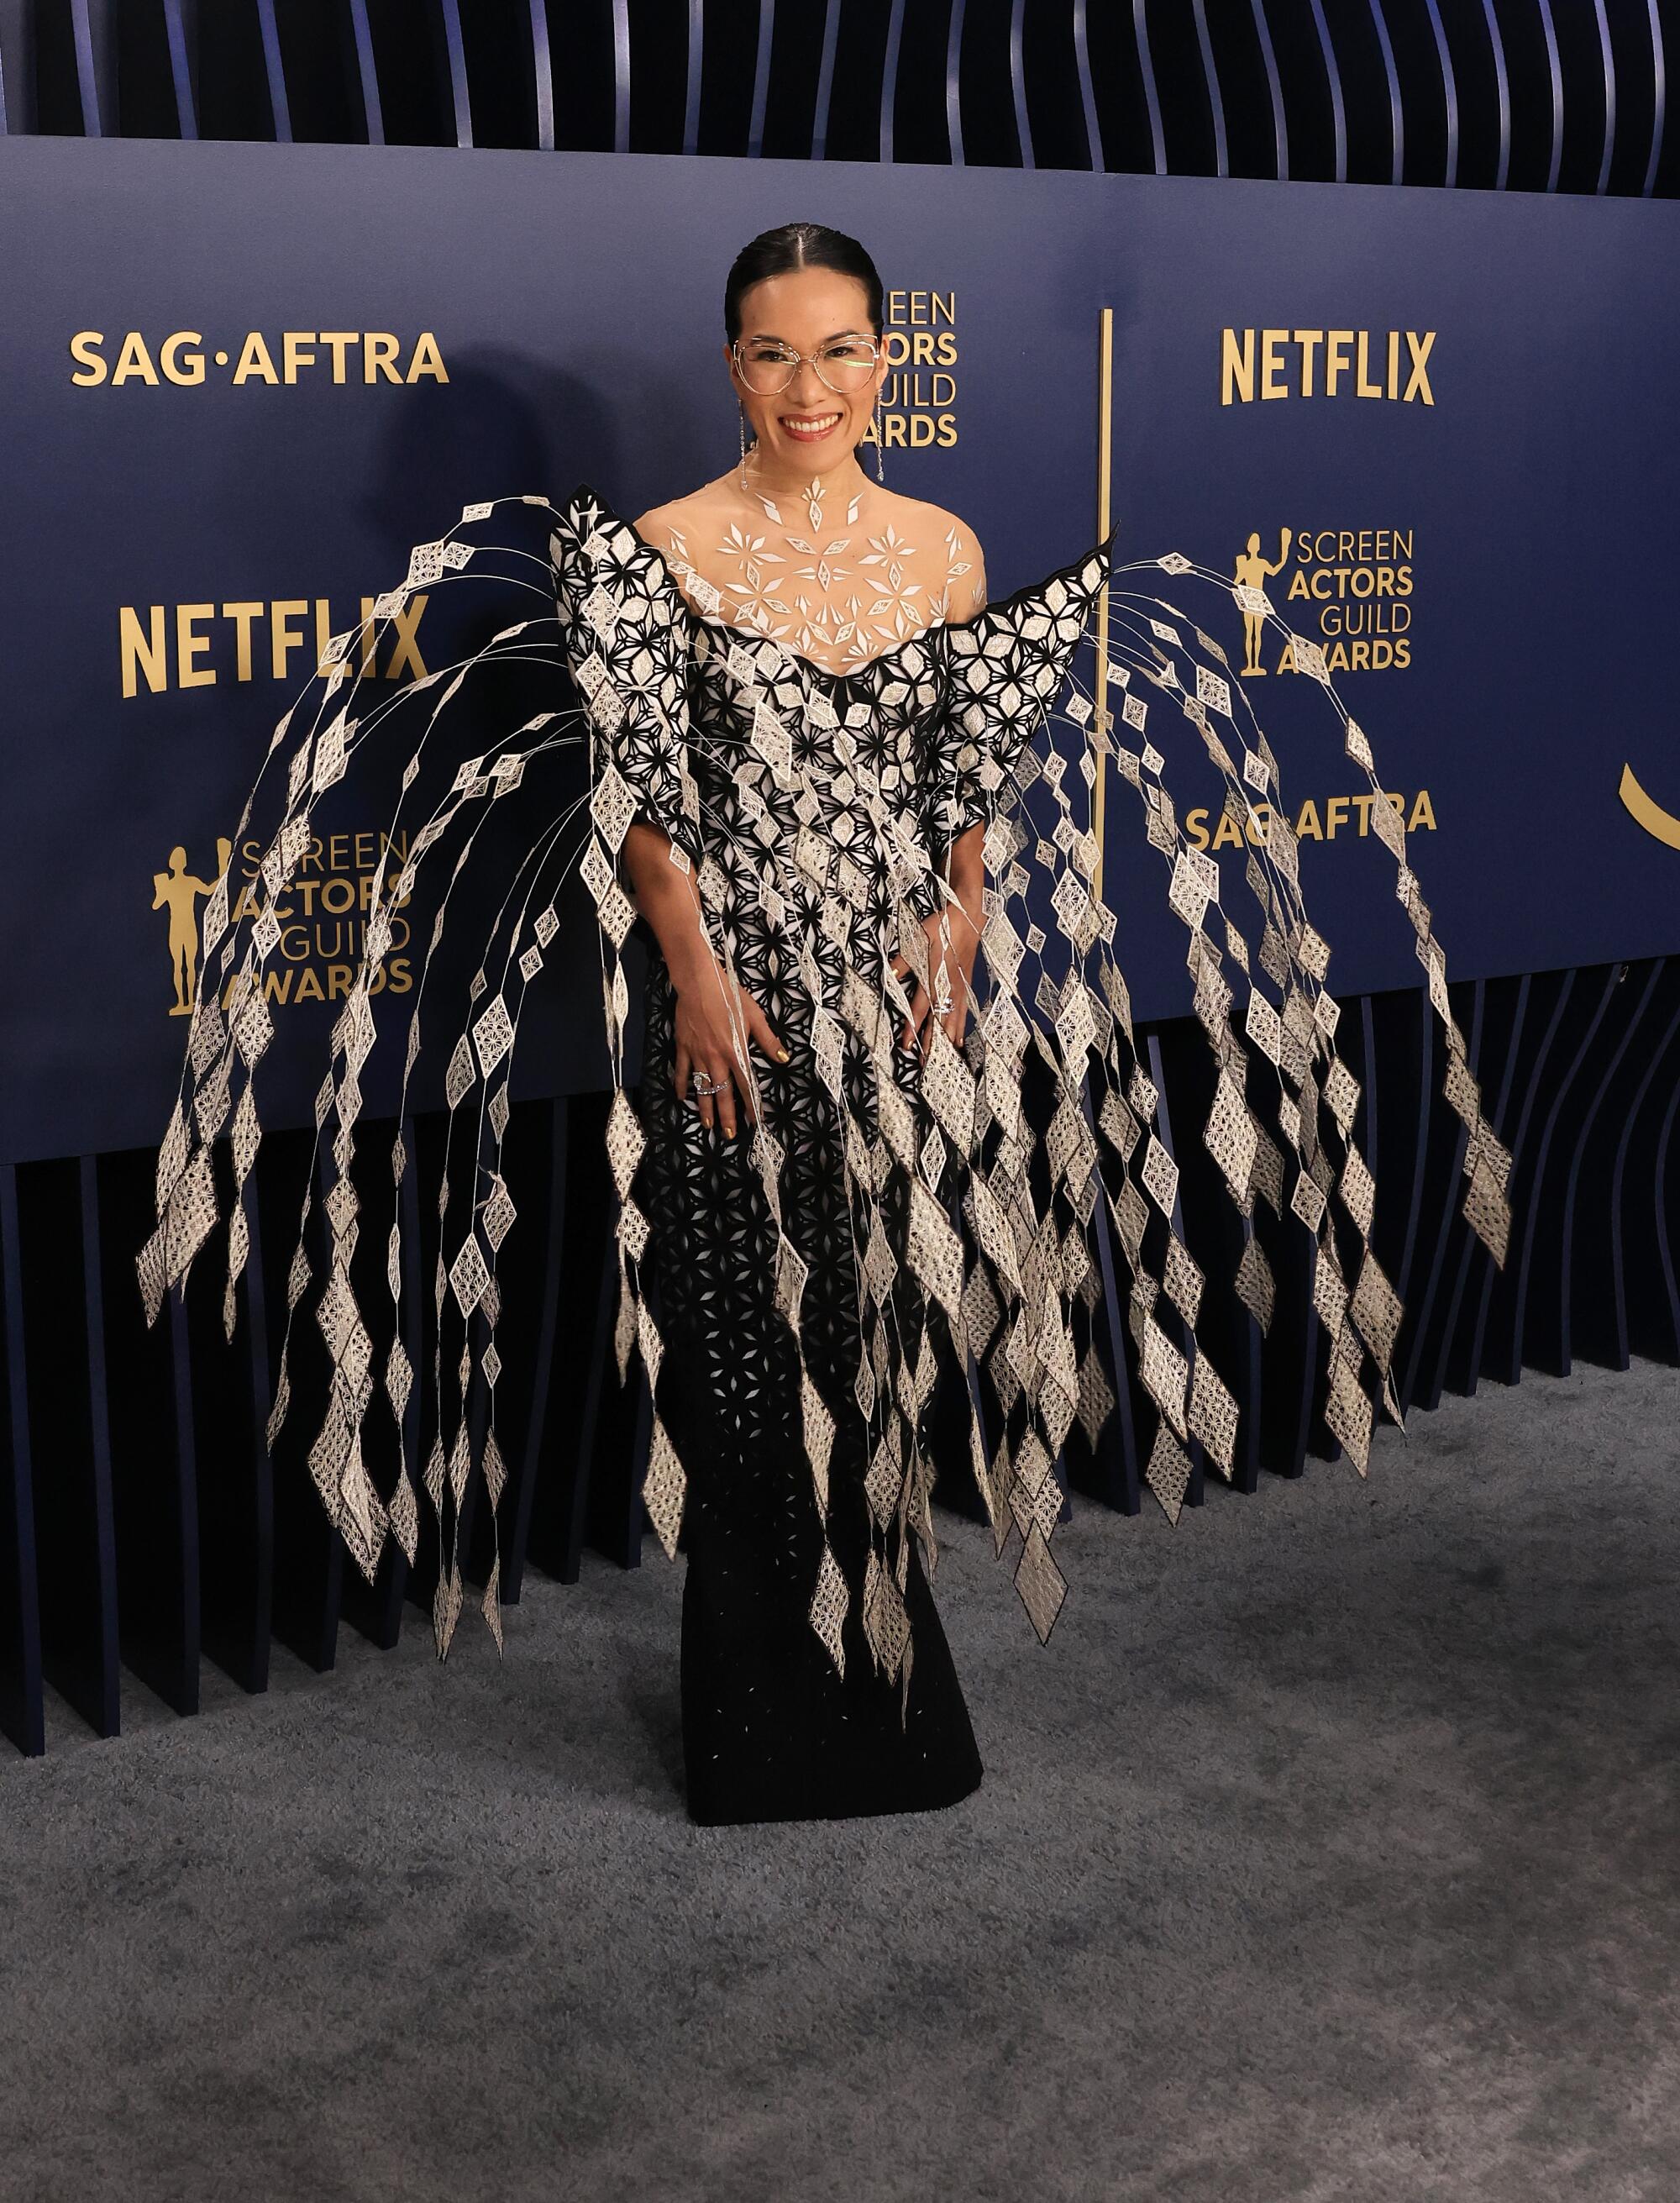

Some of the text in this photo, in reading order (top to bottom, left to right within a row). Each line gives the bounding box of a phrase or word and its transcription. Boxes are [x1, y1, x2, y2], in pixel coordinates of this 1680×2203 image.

[889, 291, 955, 326] EEN
[70, 331, 449, 386] SAG·AFTRA
[885, 332, 958, 366] ORS
[1221, 329, 1436, 406] NETFLIX
[879, 373, 957, 407] UILD
[860, 413, 958, 448] ARDS
[1297, 529, 1414, 564] SCREEN
[1287, 565, 1414, 601] ACTORS
[1320, 603, 1411, 636] GUILD
[120, 595, 429, 698] NETFLIX
[1276, 639, 1410, 675] AARDS
[1185, 790, 1437, 852] SAGAFTA
[241, 830, 407, 879] SREEN
